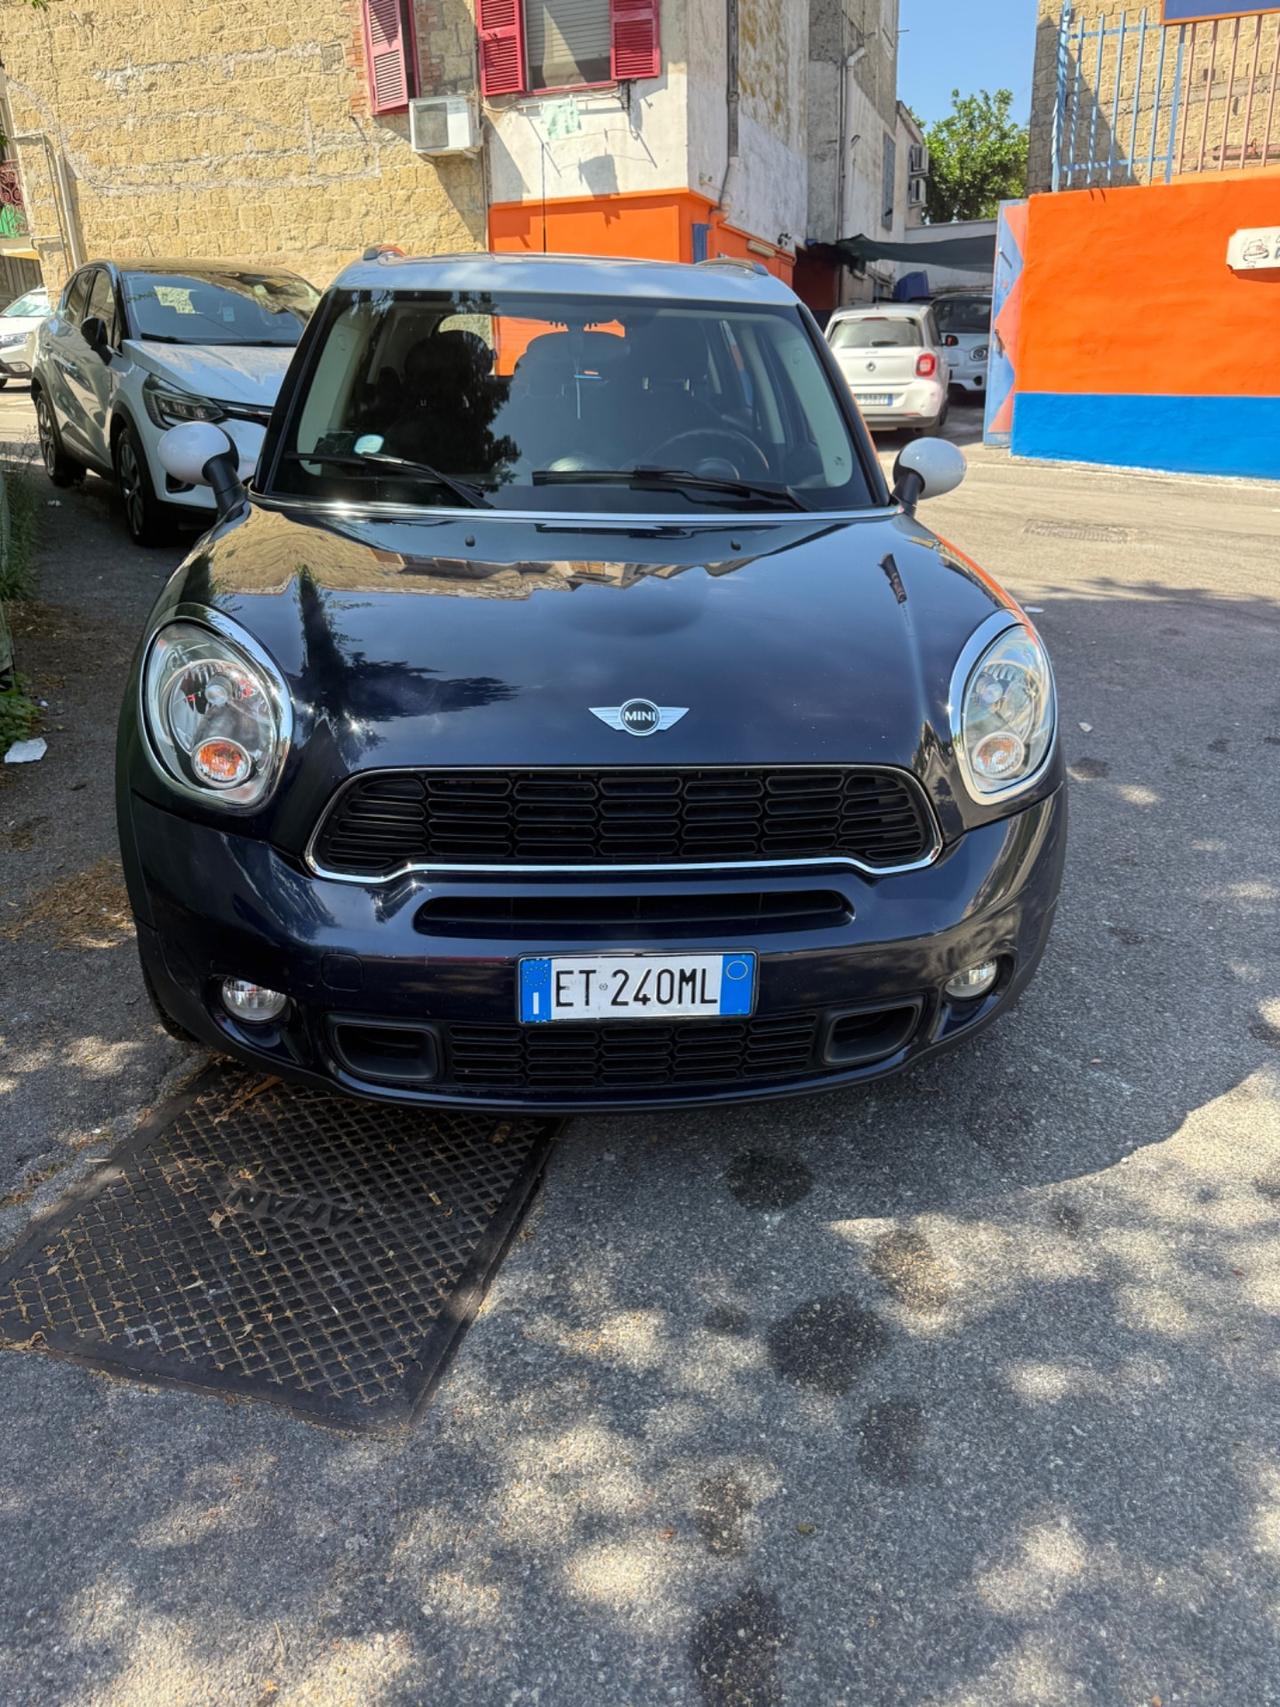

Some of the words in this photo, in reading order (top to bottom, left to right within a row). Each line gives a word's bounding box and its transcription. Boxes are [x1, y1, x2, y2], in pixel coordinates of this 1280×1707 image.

[625, 711, 656, 721] MINI
[555, 969, 597, 1008] ET
[610, 968, 718, 1007] 240ML
